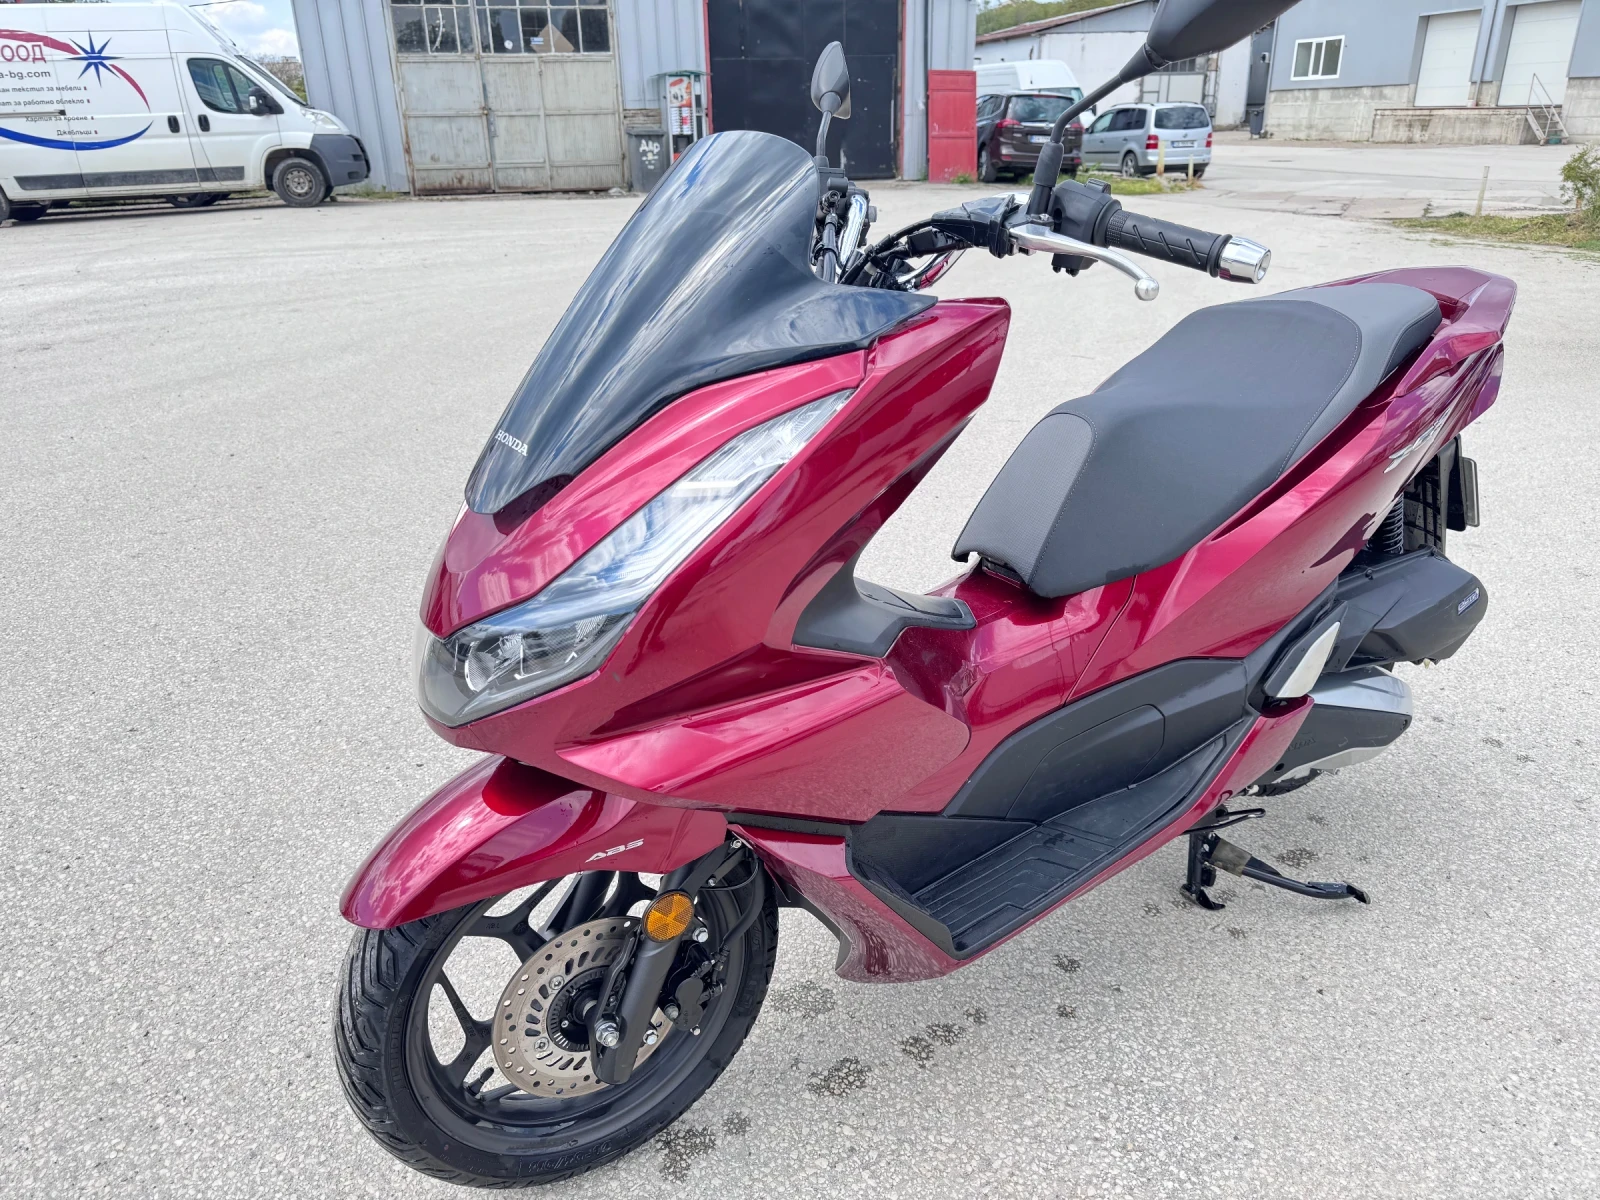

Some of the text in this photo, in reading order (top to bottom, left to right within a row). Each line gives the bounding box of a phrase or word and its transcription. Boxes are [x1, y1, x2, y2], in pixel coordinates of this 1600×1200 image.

[1, 44, 47, 64] ООД
[23, 98, 55, 107] работно
[495, 430, 528, 456] HONDA
[585, 838, 644, 863] ABS
